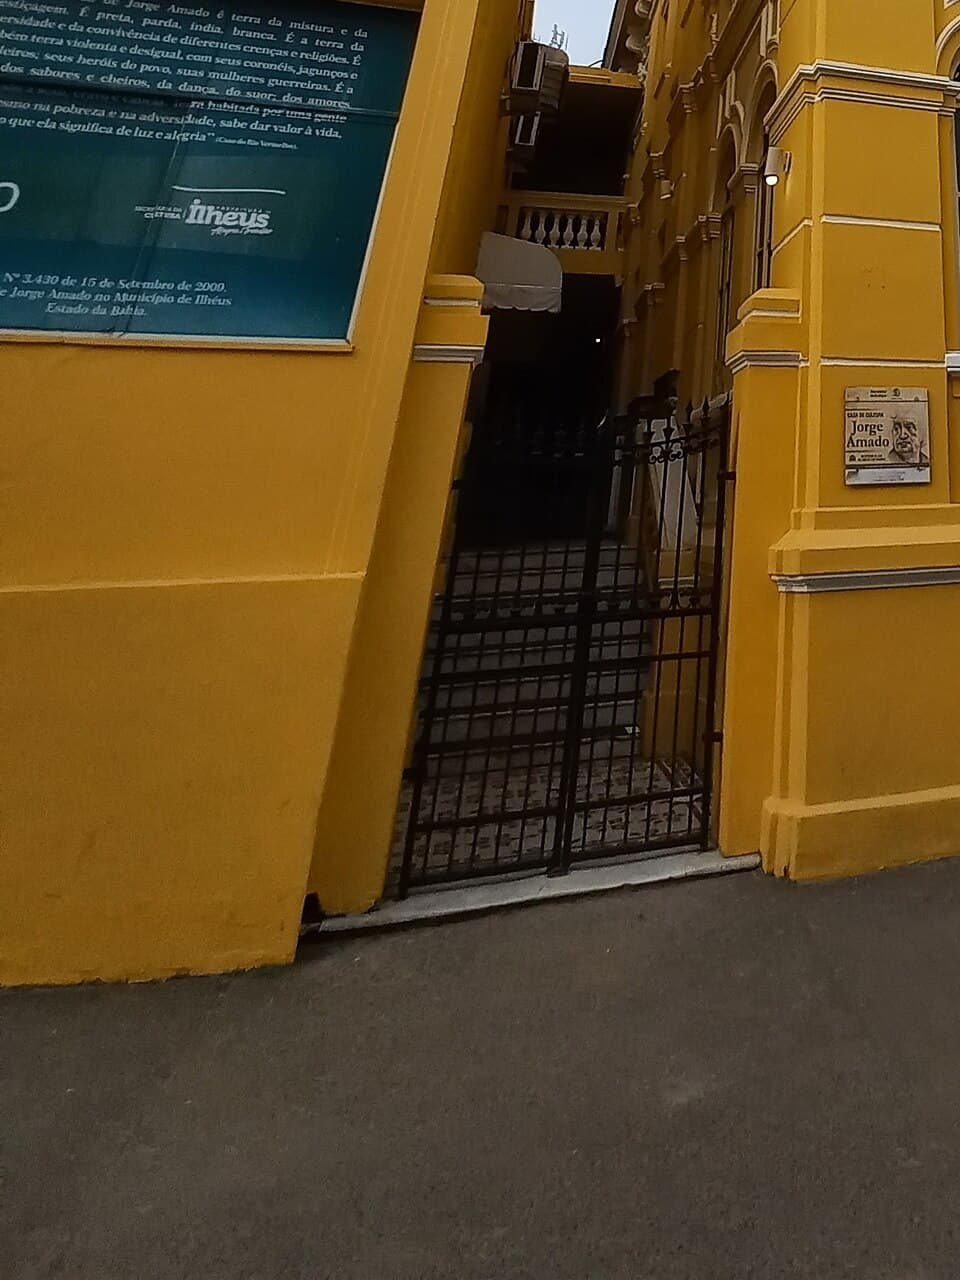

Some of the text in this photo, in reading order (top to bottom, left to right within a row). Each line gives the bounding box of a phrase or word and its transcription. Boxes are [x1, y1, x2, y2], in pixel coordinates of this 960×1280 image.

[168, 4, 210, 17] Amado
[232, 14, 261, 24] terra
[268, 17, 283, 27] da
[290, 21, 335, 33] mistura
[341, 28, 349, 36] e
[353, 28, 368, 38] da
[68, 21, 85, 32] da
[162, 33, 179, 43] de
[179, 35, 242, 50] diferentes
[242, 45, 290, 57] crenças
[352, 54, 362, 66] É
[284, 32, 296, 43] É
[299, 37, 308, 45] a
[315, 39, 345, 50] terra
[350, 41, 366, 52] da
[31, 35, 64, 46] terra
[66, 39, 118, 52] violenta
[119, 46, 128, 54] e
[185, 54, 213, 63] com
[214, 56, 242, 66] seus
[296, 65, 350, 78] jagunços
[0, 62, 25, 73] dos
[30, 66, 81, 80] sabores
[85, 73, 95, 81] e
[156, 80, 174, 90] da
[225, 86, 242, 97] do
[282, 93, 304, 104] dos
[43, 52, 75, 64] seus
[76, 54, 119, 68] heróis
[120, 59, 138, 70] do
[176, 68, 205, 78] suas
[206, 71, 266, 85] mulheres
[334, 81, 345, 93] É
[346, 87, 354, 95] a
[32, 102, 51, 112] na
[52, 103, 105, 117] pobreza
[107, 109, 118, 118] e
[119, 111, 137, 120] na
[219, 117, 249, 129] sabe
[249, 120, 272, 131] dar
[272, 123, 304, 134] valor
[304, 125, 313, 136] à
[208, 100, 260, 115] habitada
[261, 107, 285, 118] por
[8, 118, 36, 128] que
[37, 117, 57, 130] ela
[59, 120, 114, 135] significa
[115, 124, 133, 137] de
[134, 126, 155, 139] luz
[155, 131, 164, 140] e
[60, 275, 78, 288] de
[98, 277, 116, 289] de
[117, 278, 175, 291] Setembro
[177, 280, 193, 291] de
[9, 286, 46, 301] Jorge
[48, 288, 93, 301] Amado
[93, 292, 111, 302] no
[177, 294, 193, 305] de
[194, 294, 233, 307] Ilhéus
[45, 302, 90, 315] Estado
[91, 304, 108, 316] da
[850, 419, 885, 437] Jorge
[846, 434, 890, 449] Amado
